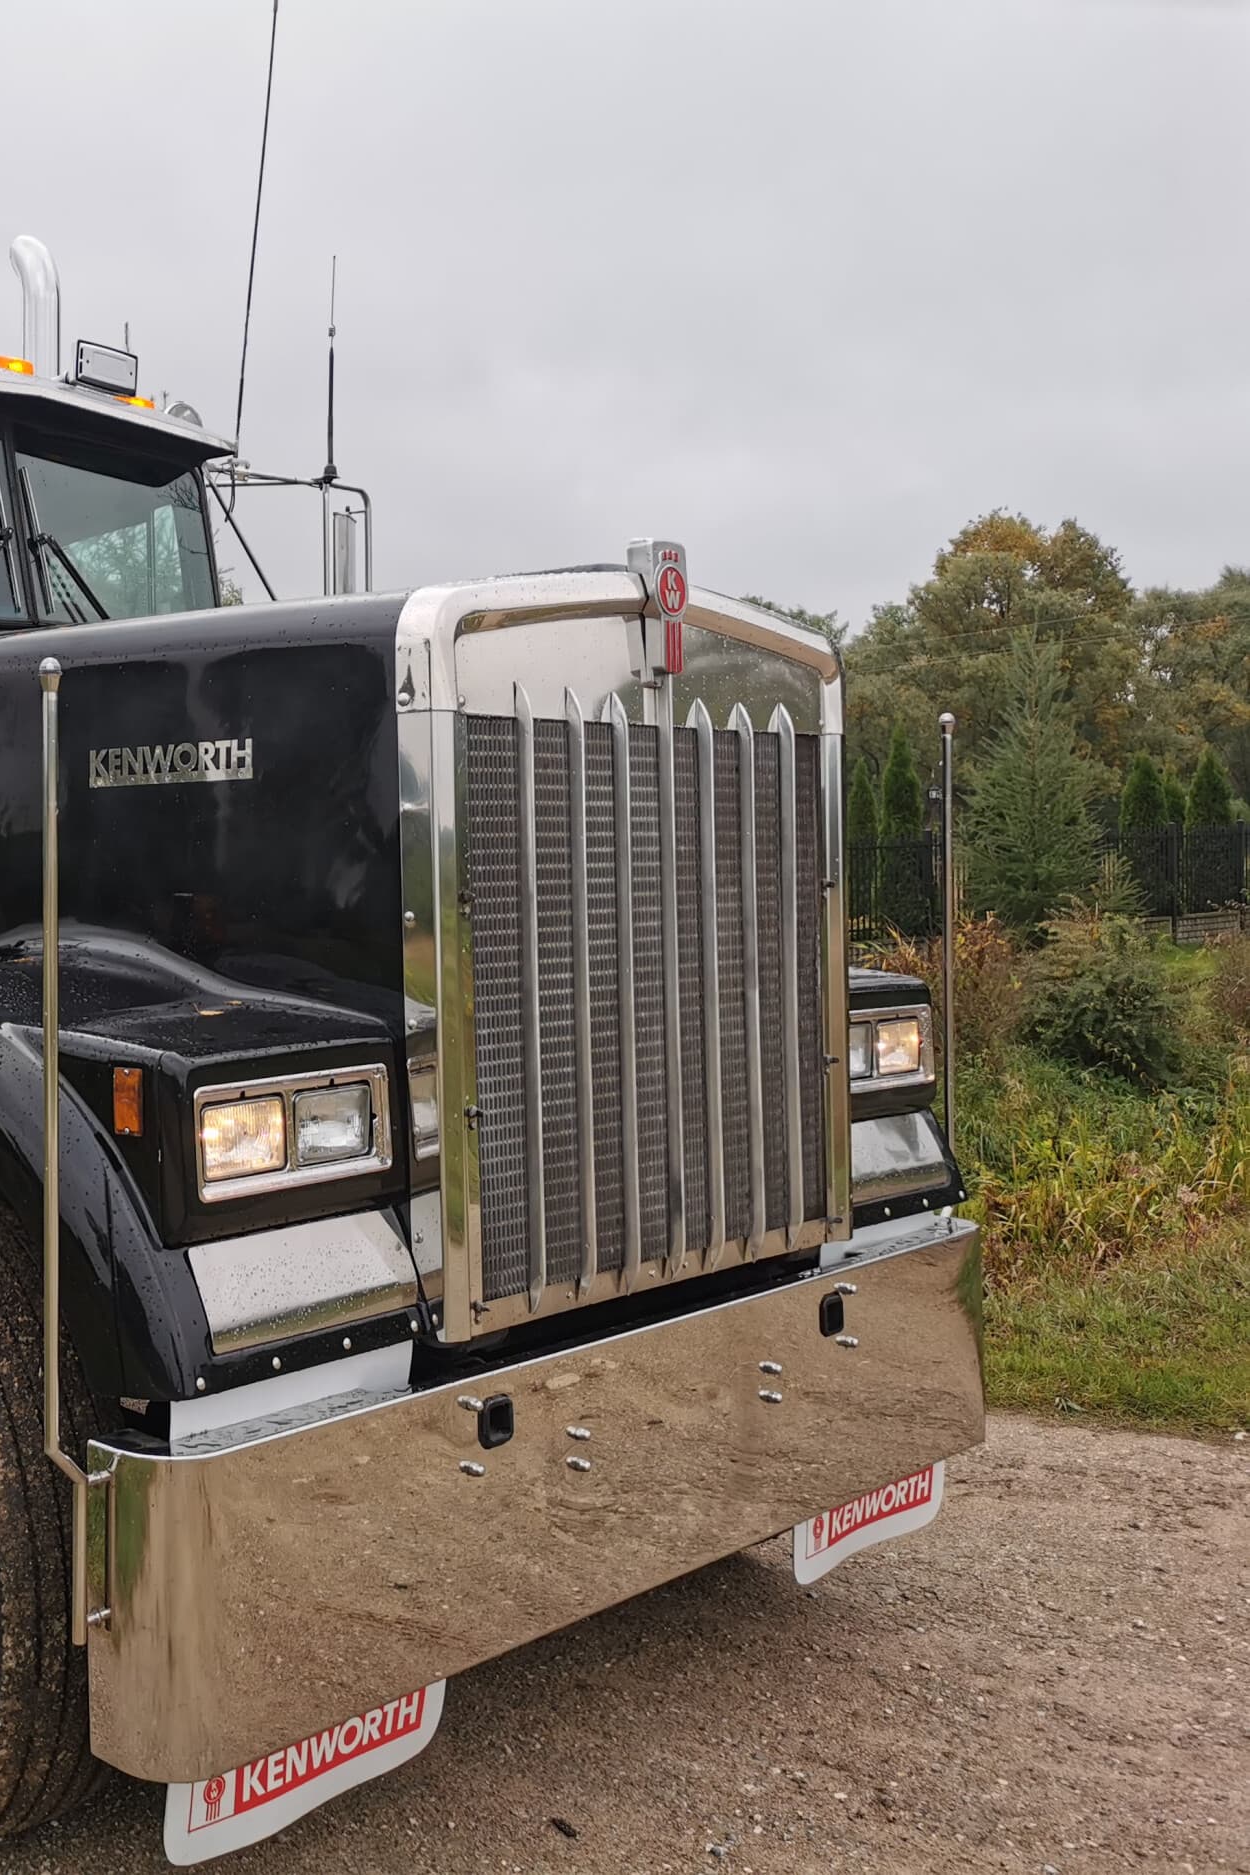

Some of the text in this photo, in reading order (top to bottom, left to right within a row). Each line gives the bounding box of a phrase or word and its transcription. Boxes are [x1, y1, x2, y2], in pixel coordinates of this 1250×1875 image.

[89, 738, 253, 784] KENWORTH
[831, 1470, 930, 1538] KENWORTH
[242, 1691, 420, 1802] KENWORTH
